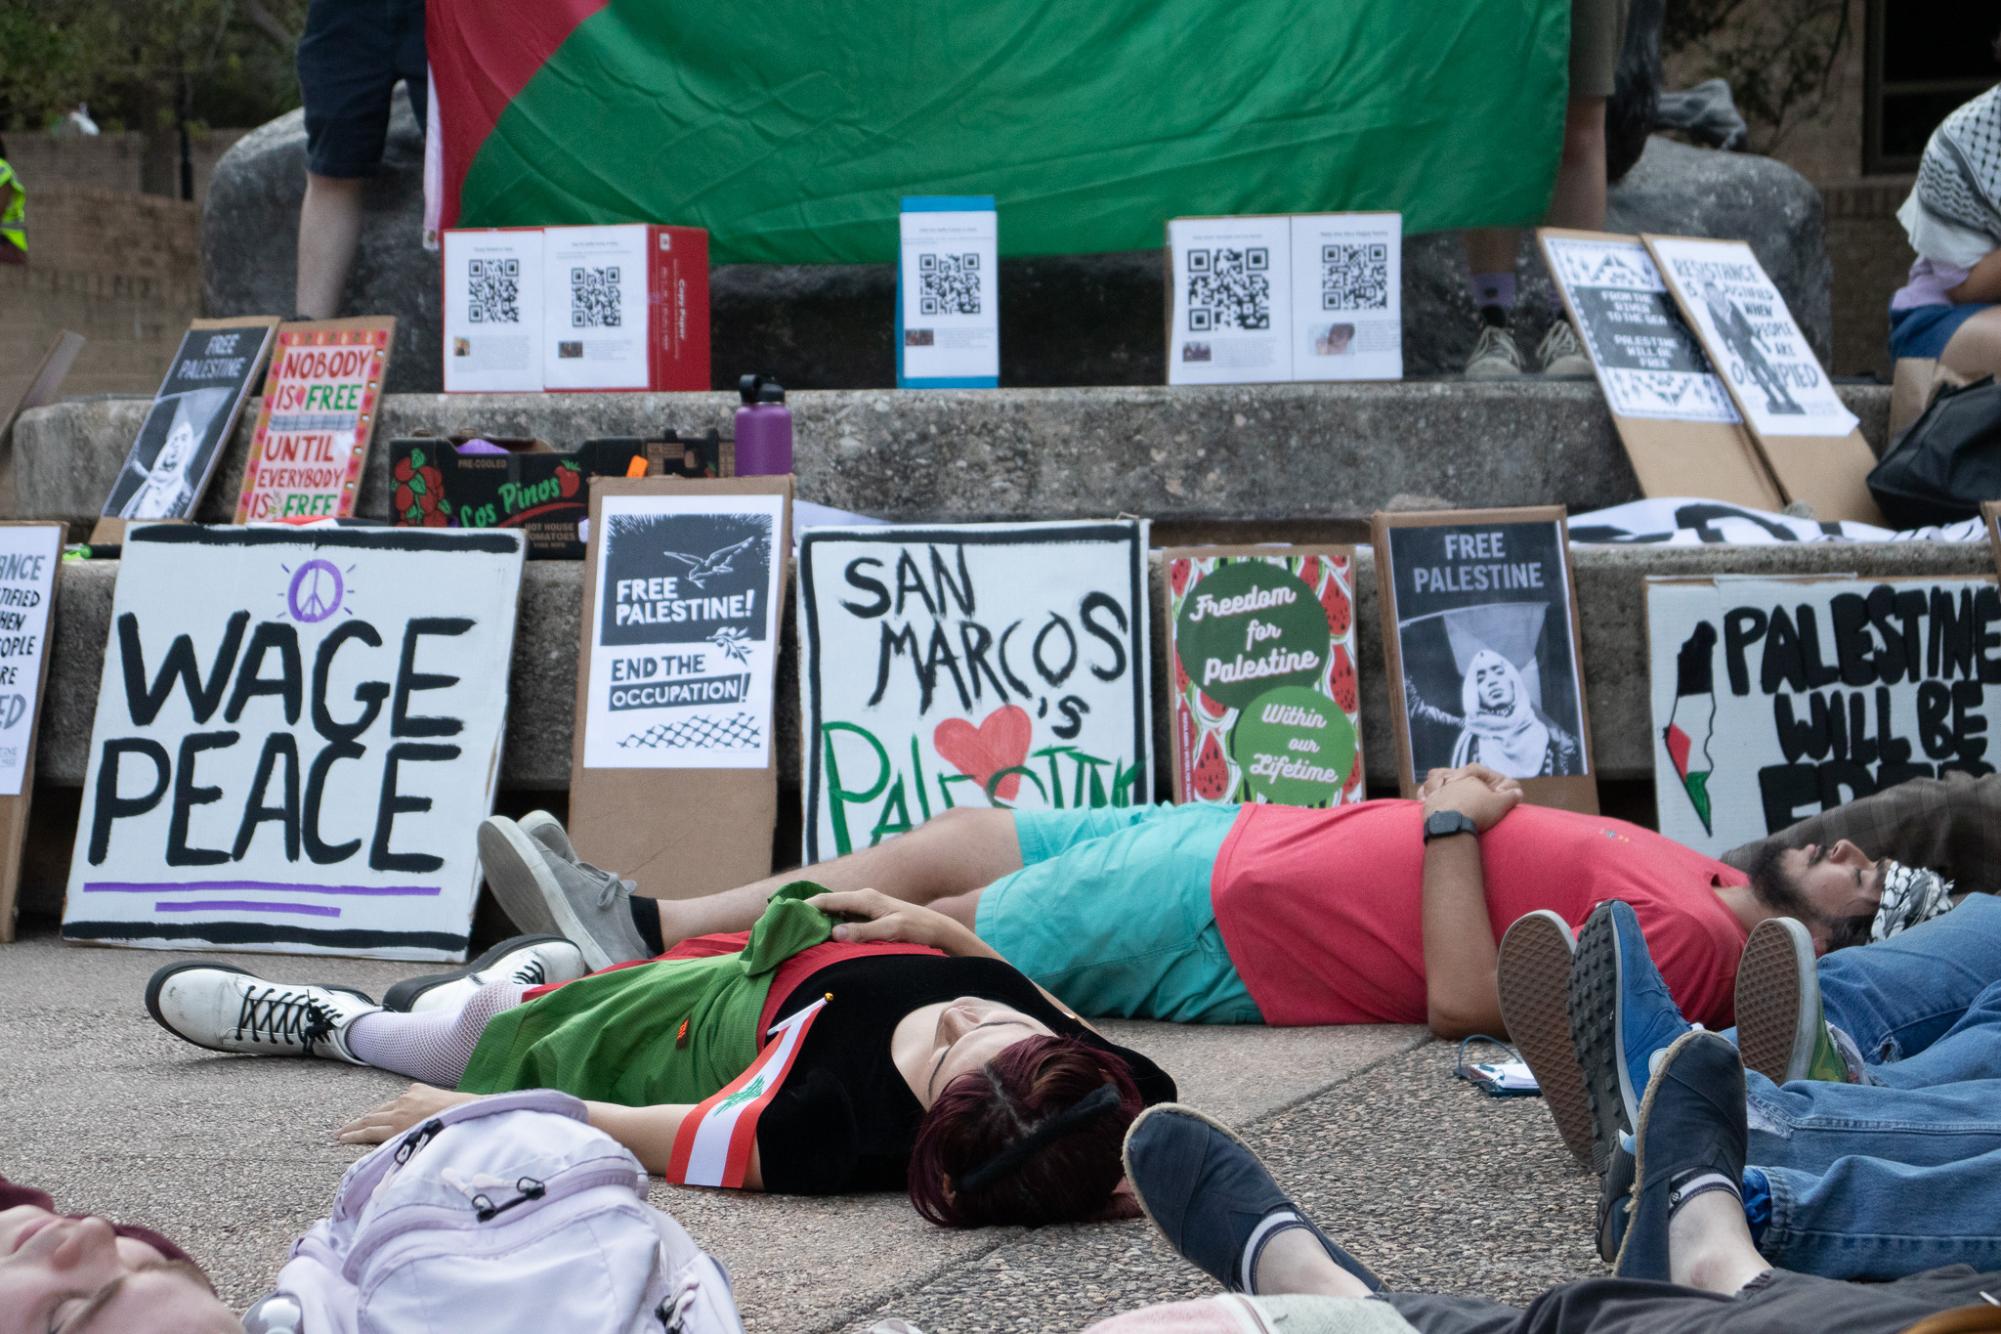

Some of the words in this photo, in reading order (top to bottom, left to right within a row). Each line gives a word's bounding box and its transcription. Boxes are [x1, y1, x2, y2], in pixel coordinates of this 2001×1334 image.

[1672, 259, 1761, 283] RESISTANCE
[1606, 311, 1622, 322] TO
[1623, 312, 1643, 323] THE
[1743, 302, 1774, 316] WHEN
[1753, 322, 1794, 337] PEOPLE
[204, 333, 241, 355] FREE
[1775, 342, 1797, 356] ARE
[177, 357, 246, 380] PALESTINE
[283, 351, 371, 379] NOBODY
[276, 385, 295, 410] IS
[305, 384, 363, 411] FREE
[264, 435, 334, 462] UNTIL
[258, 468, 345, 488] EVERYBODY
[250, 493, 272, 518] IS
[283, 493, 338, 518] FREE
[498, 477, 561, 514] Pinos
[527, 532, 577, 541] OMATOES
[1444, 532, 1506, 560] FREE
[616, 577, 679, 603] FREE
[840, 543, 975, 619] SAN
[1413, 562, 1544, 594] PALESTINE
[616, 590, 756, 626] PALESTINE!
[1189, 585, 1296, 622] Freedom
[1246, 619, 1282, 652] for
[1724, 585, 2001, 696] PALESTINE
[866, 592, 1128, 715] MARCOS
[1203, 648, 1319, 686] Palestine
[118, 610, 477, 742] WAGE
[611, 657, 658, 682] END
[661, 654, 706, 677] THE
[611, 672, 751, 707] OCCUPATION!
[1261, 704, 1327, 729] Within
[1774, 686, 1912, 764] WILL
[1917, 680, 1988, 761] BE
[1288, 737, 1320, 753] our
[1249, 753, 1338, 784] Lifetime
[88, 731, 462, 872] PEACE
